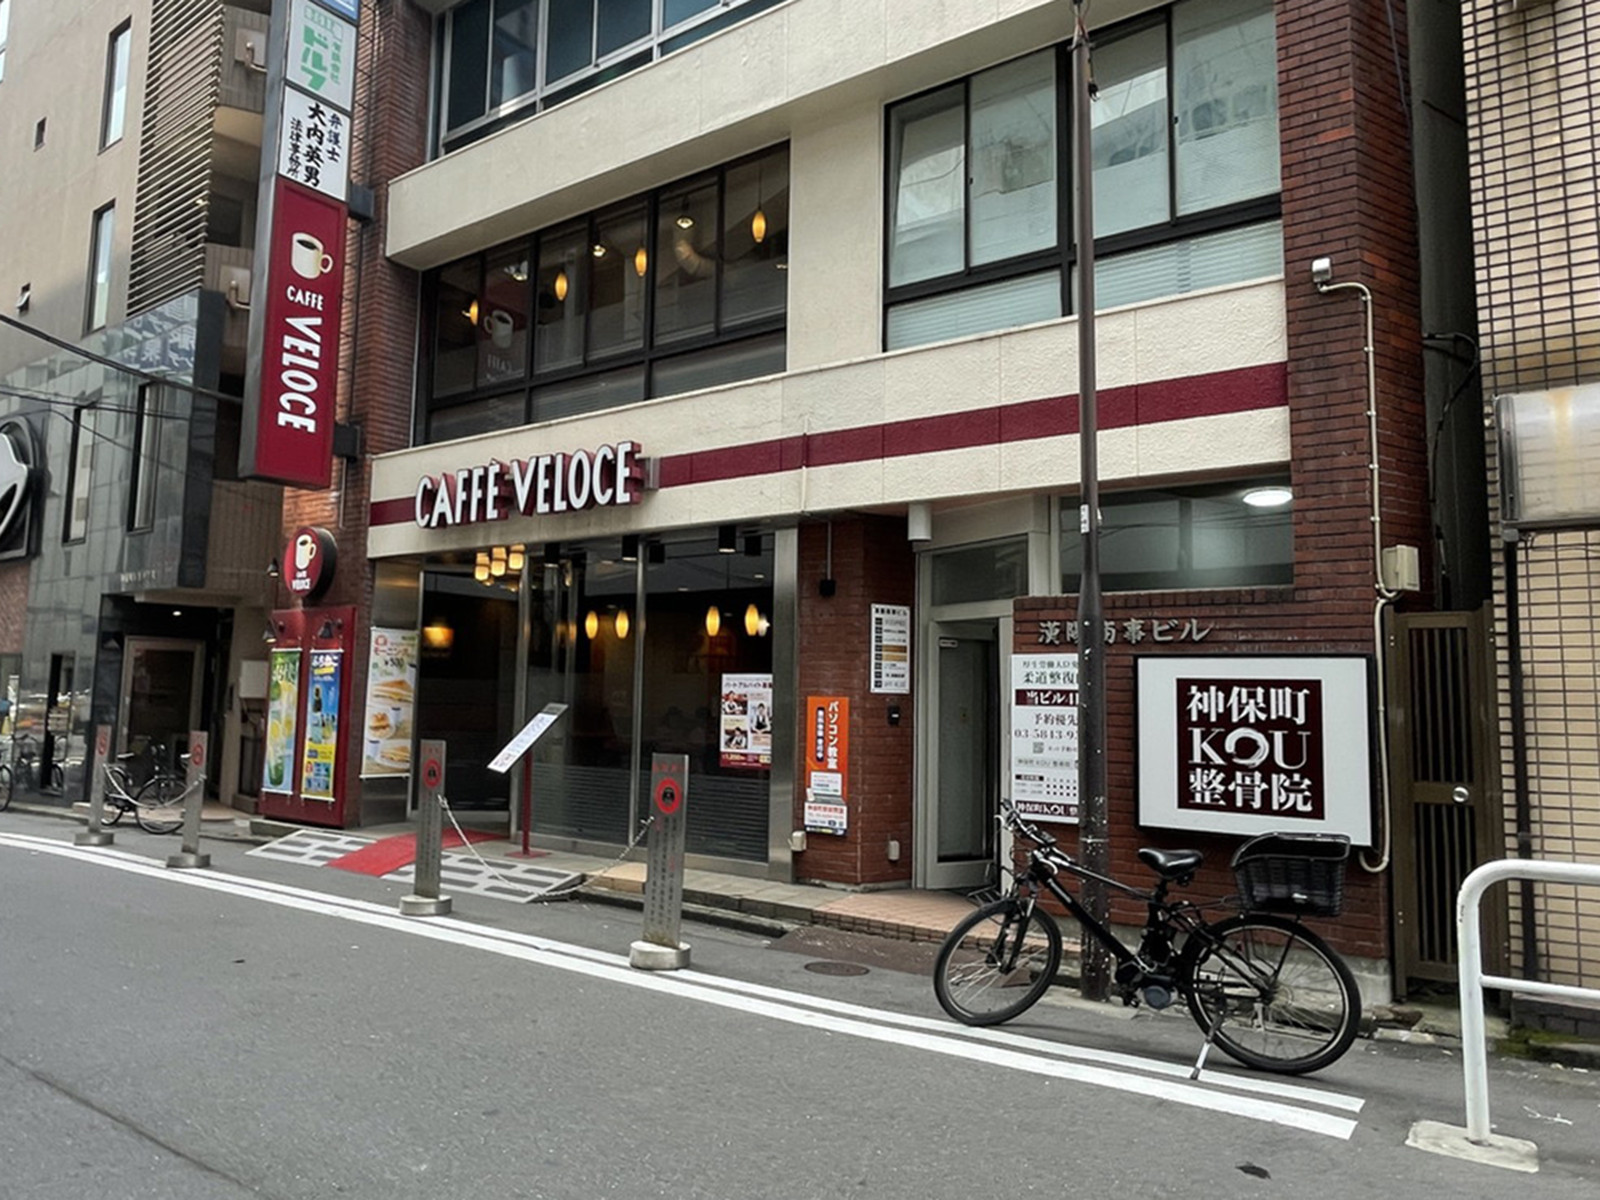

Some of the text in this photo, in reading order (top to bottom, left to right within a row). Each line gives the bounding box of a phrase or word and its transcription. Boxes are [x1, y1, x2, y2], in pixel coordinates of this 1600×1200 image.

[303, 102, 327, 188] 大内英男
[326, 113, 343, 163] 弁護士
[277, 316, 323, 434] VELOCE
[510, 440, 635, 516] VELOCE
[1023, 670, 1078, 685] 柔道整復
[1186, 685, 1310, 725] 神保町
[1187, 727, 1312, 770] KOU
[1189, 768, 1313, 812] 整骨院
